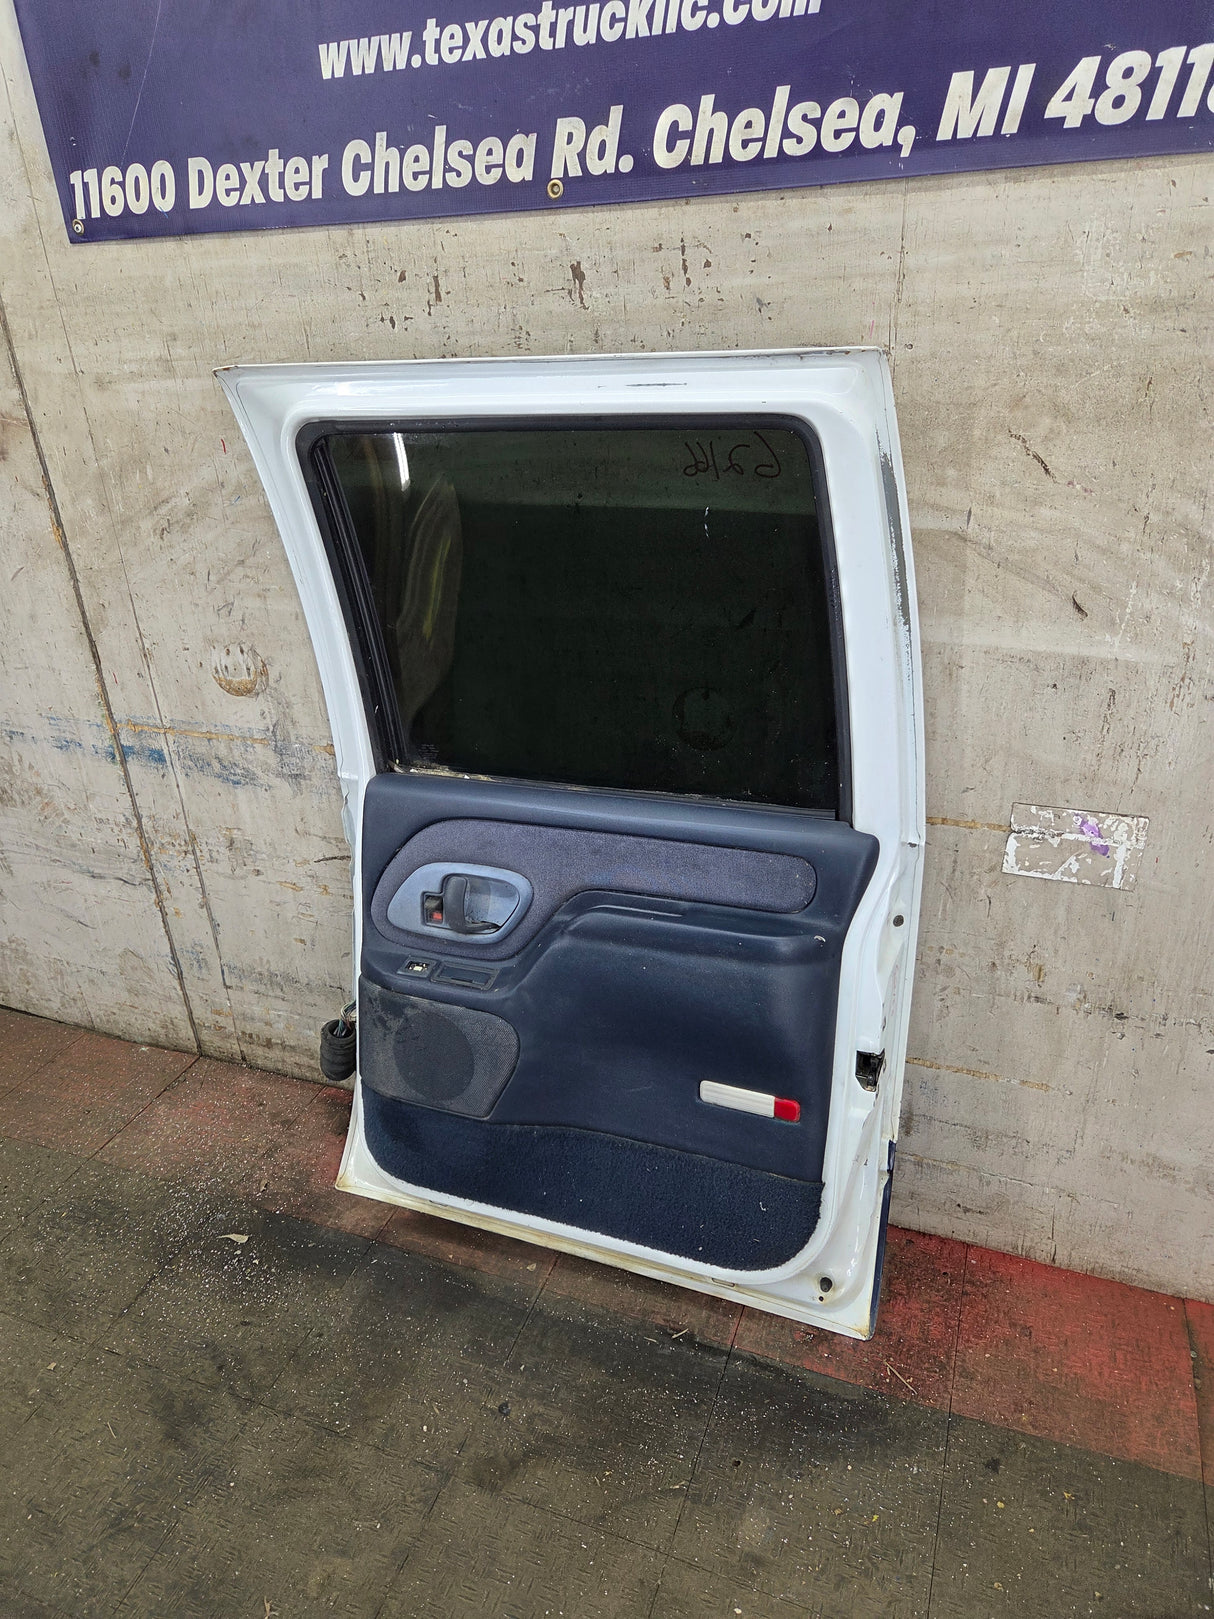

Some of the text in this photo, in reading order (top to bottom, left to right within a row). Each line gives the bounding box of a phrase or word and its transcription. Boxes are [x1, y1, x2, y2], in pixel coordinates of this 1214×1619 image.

[70, 43, 1214, 220] 11600 Dexter Chelsea Rd. Chelsea, MI 4811
